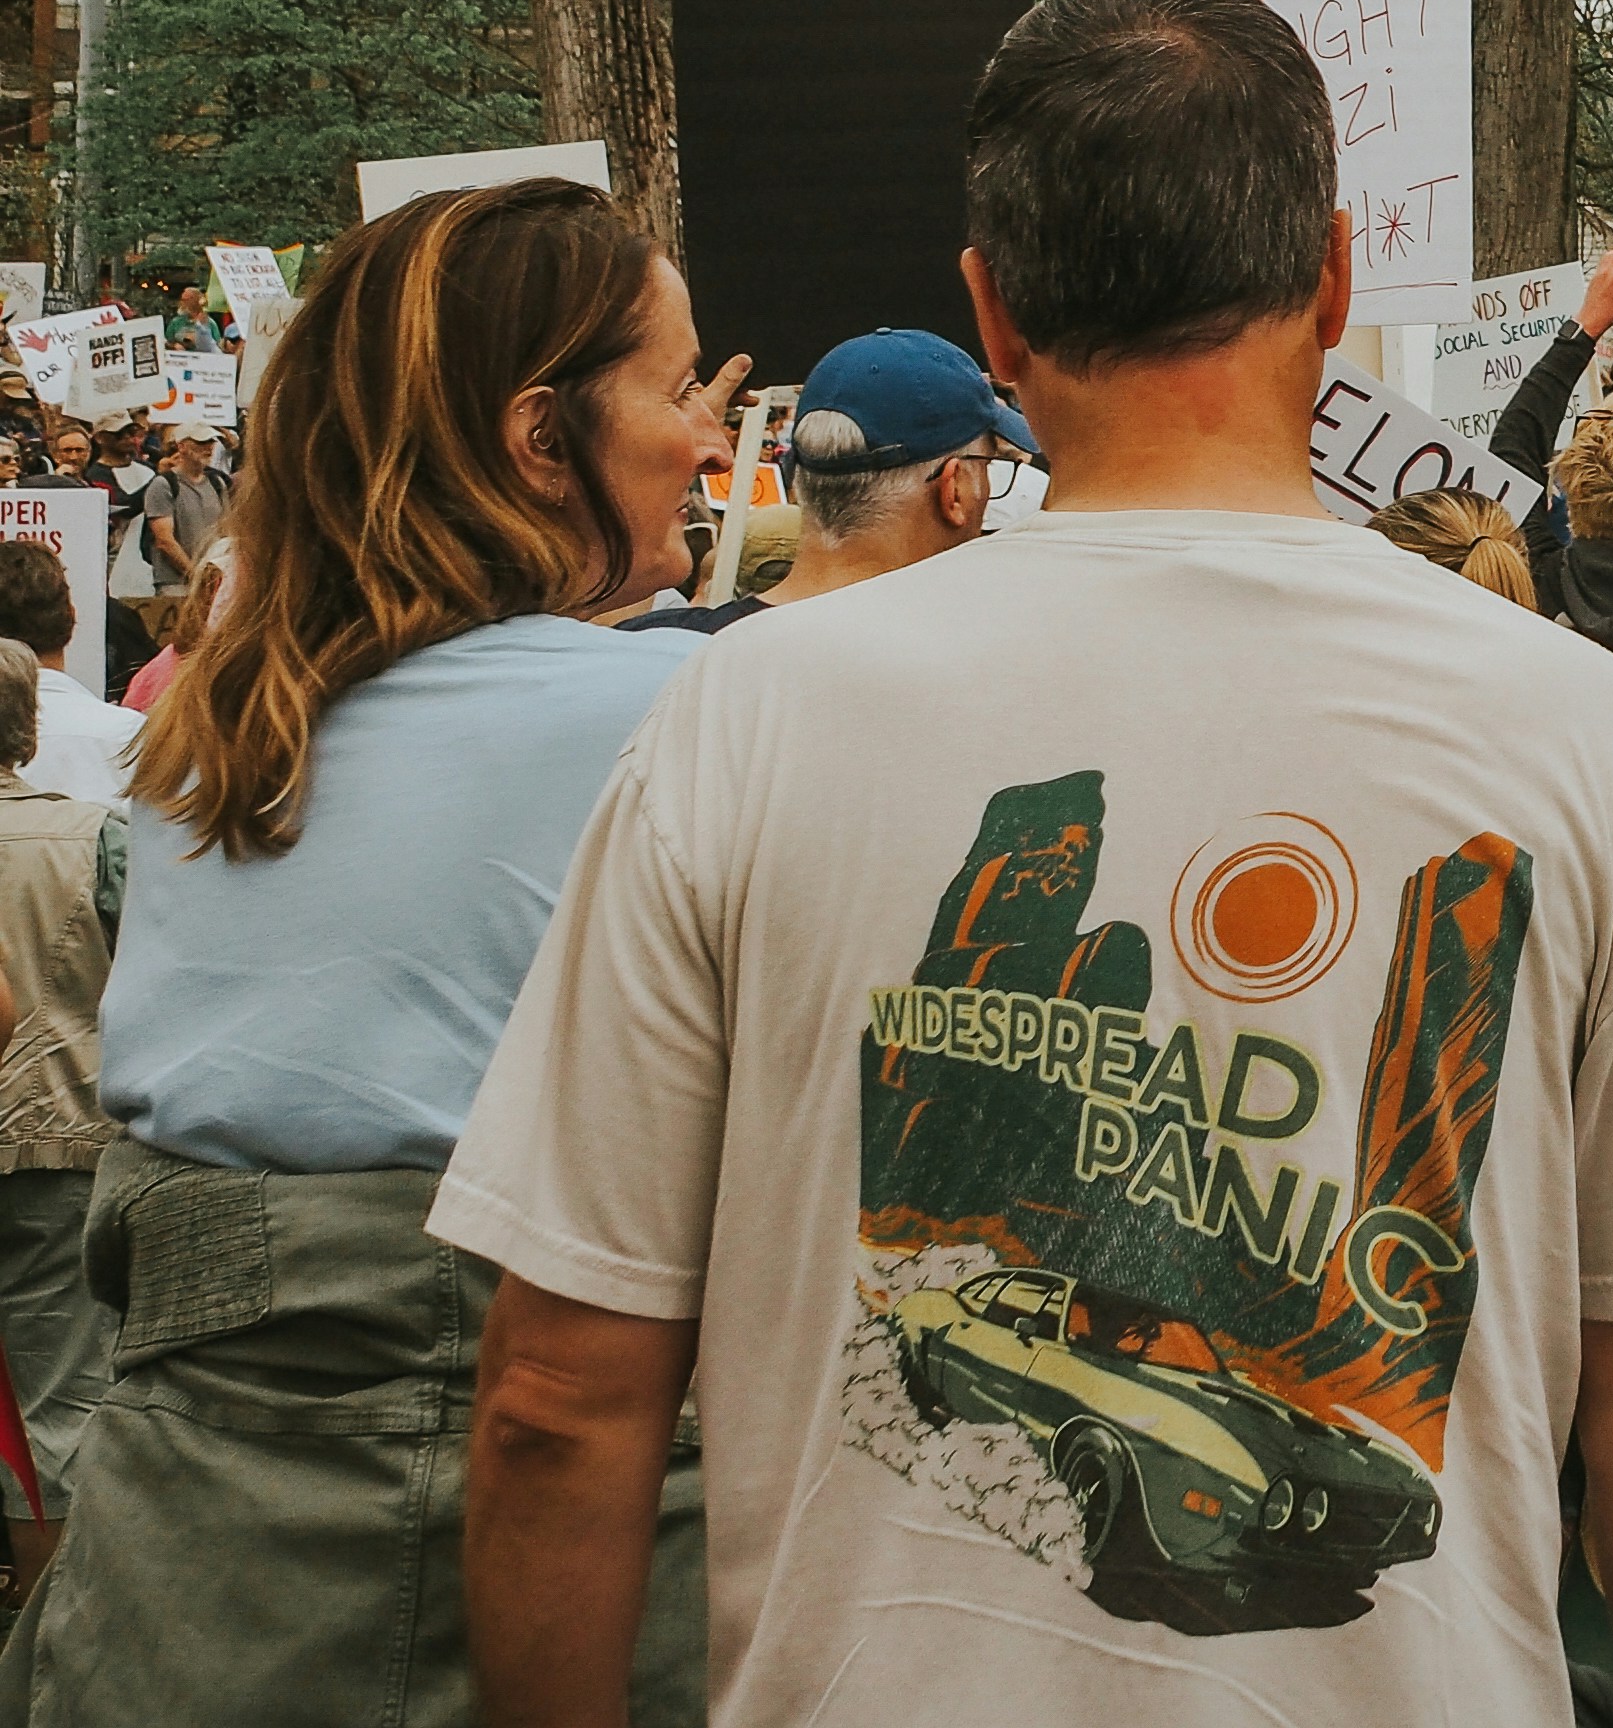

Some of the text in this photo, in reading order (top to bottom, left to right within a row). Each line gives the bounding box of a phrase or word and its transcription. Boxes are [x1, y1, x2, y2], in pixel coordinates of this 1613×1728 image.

[89, 333, 125, 350] HANDS
[91, 347, 125, 368] OFF!
[1484, 354, 1522, 384] AND
[0, 500, 47, 525] PER
[869, 983, 1327, 1145] WIDESPREAD
[1074, 1092, 1466, 1338] PANIC
